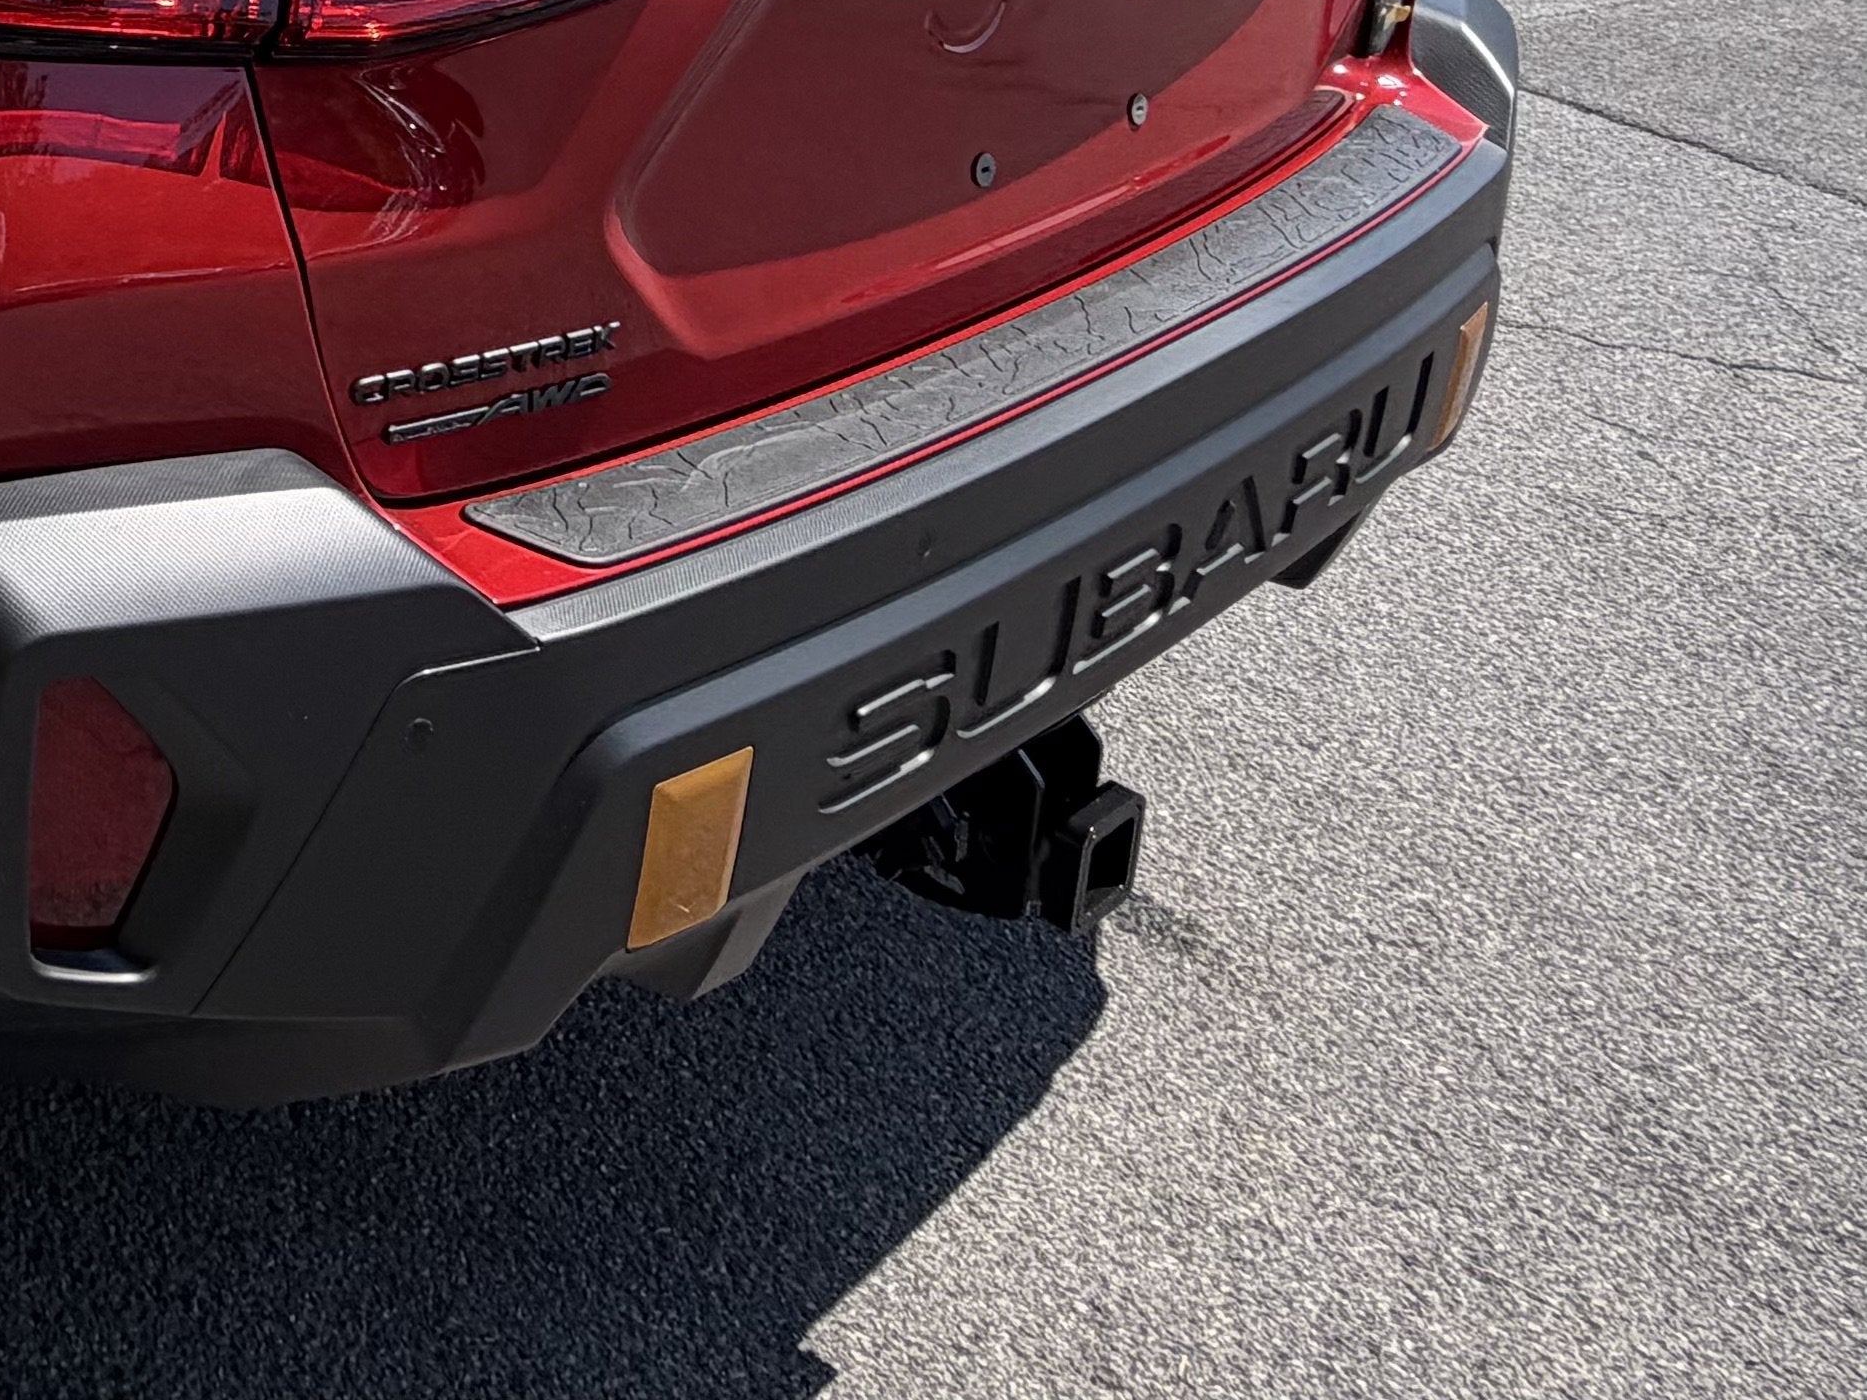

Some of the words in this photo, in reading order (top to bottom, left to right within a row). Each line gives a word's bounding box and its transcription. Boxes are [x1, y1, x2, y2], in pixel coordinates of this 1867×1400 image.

[351, 321, 621, 404] CROSSTREK
[478, 372, 613, 425] AWD
[818, 351, 1434, 815] SUBARU
